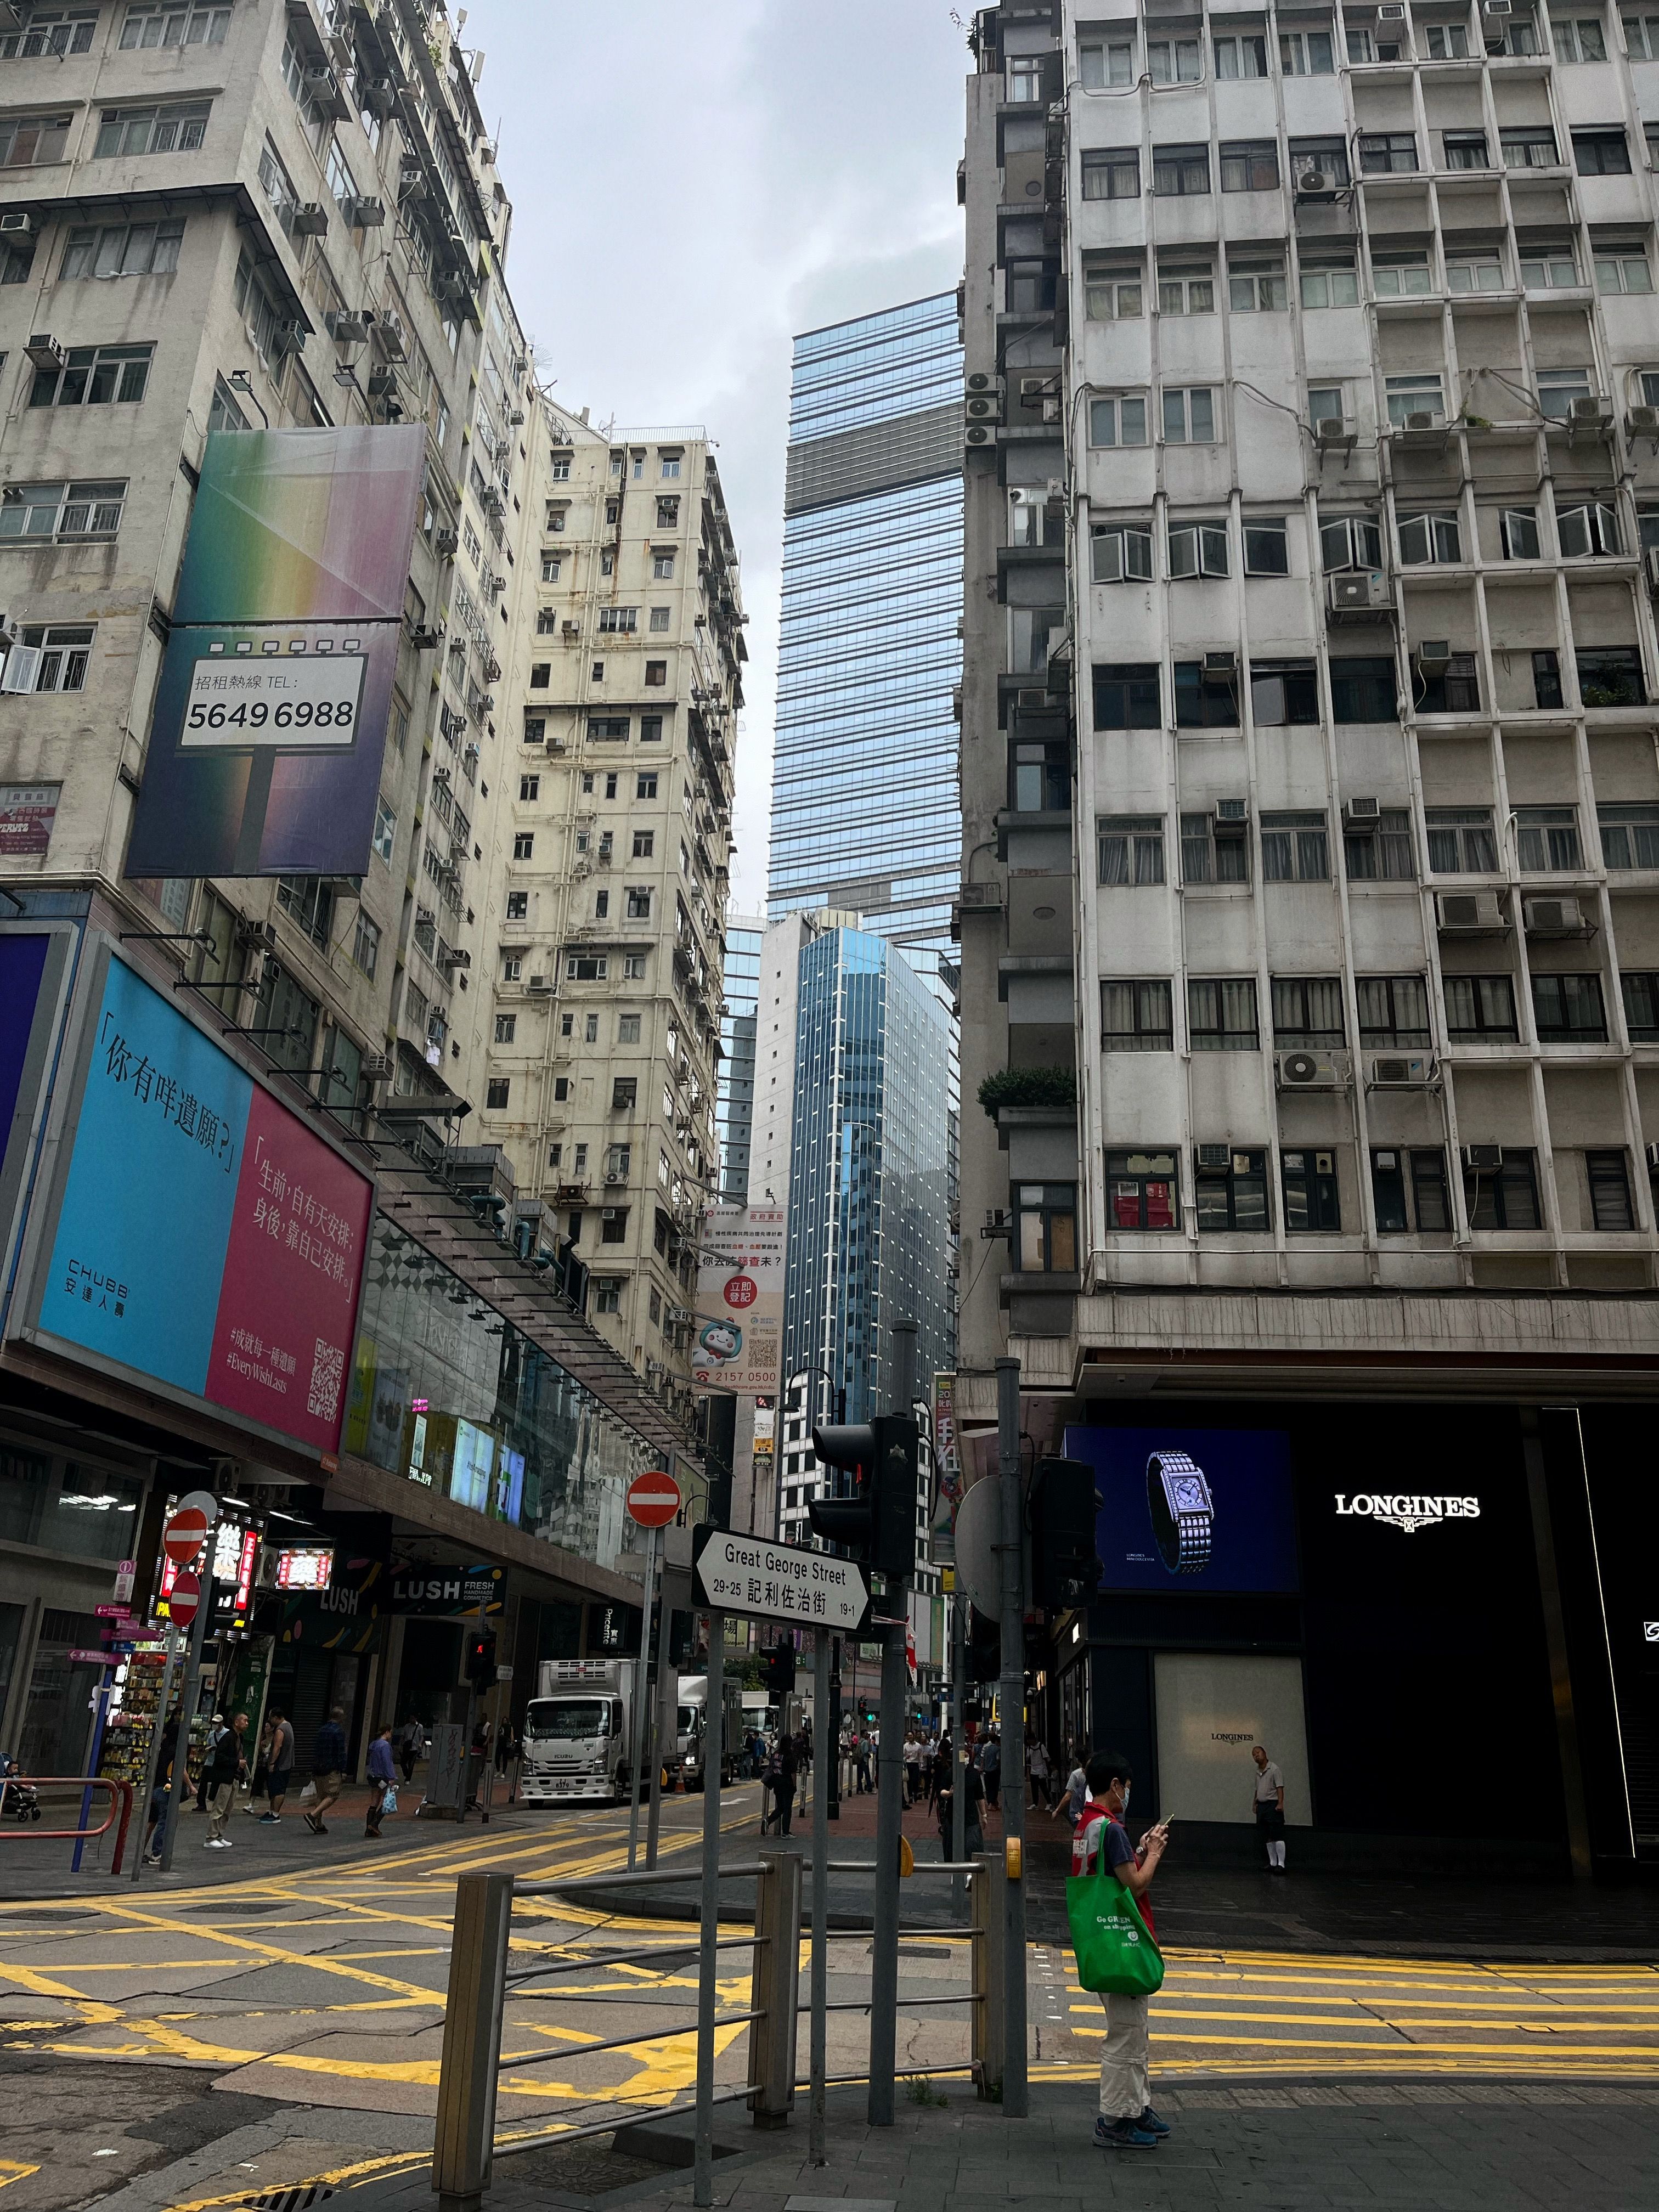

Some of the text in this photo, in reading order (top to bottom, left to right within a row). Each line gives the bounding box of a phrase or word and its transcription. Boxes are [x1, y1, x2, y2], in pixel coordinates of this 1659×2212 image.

[195, 675, 262, 690] 招租熱線
[187, 701, 353, 729] 5649 6988
[69, 1259, 128, 1299] CHUBB
[730, 1282, 752, 1291] 立即
[64, 1277, 125, 1318] 安達人壽
[729, 1292, 751, 1302] 登記
[230, 1327, 297, 1376] #成就每一種遺願
[226, 1351, 287, 1395] #EveryWishLasts
[715, 1372, 776, 1381] 2157 0500
[1335, 1494, 1481, 1517] LONGINES
[288, 1555, 319, 1584] 藥
[725, 1543, 846, 1585] Great George Street
[320, 1585, 360, 1615] LUSH
[393, 1581, 460, 1600] LUSH
[465, 1582, 495, 1590] FRESH
[748, 1578, 826, 1615] 記利佐治街
[603, 1609, 613, 1645] Pricerite
